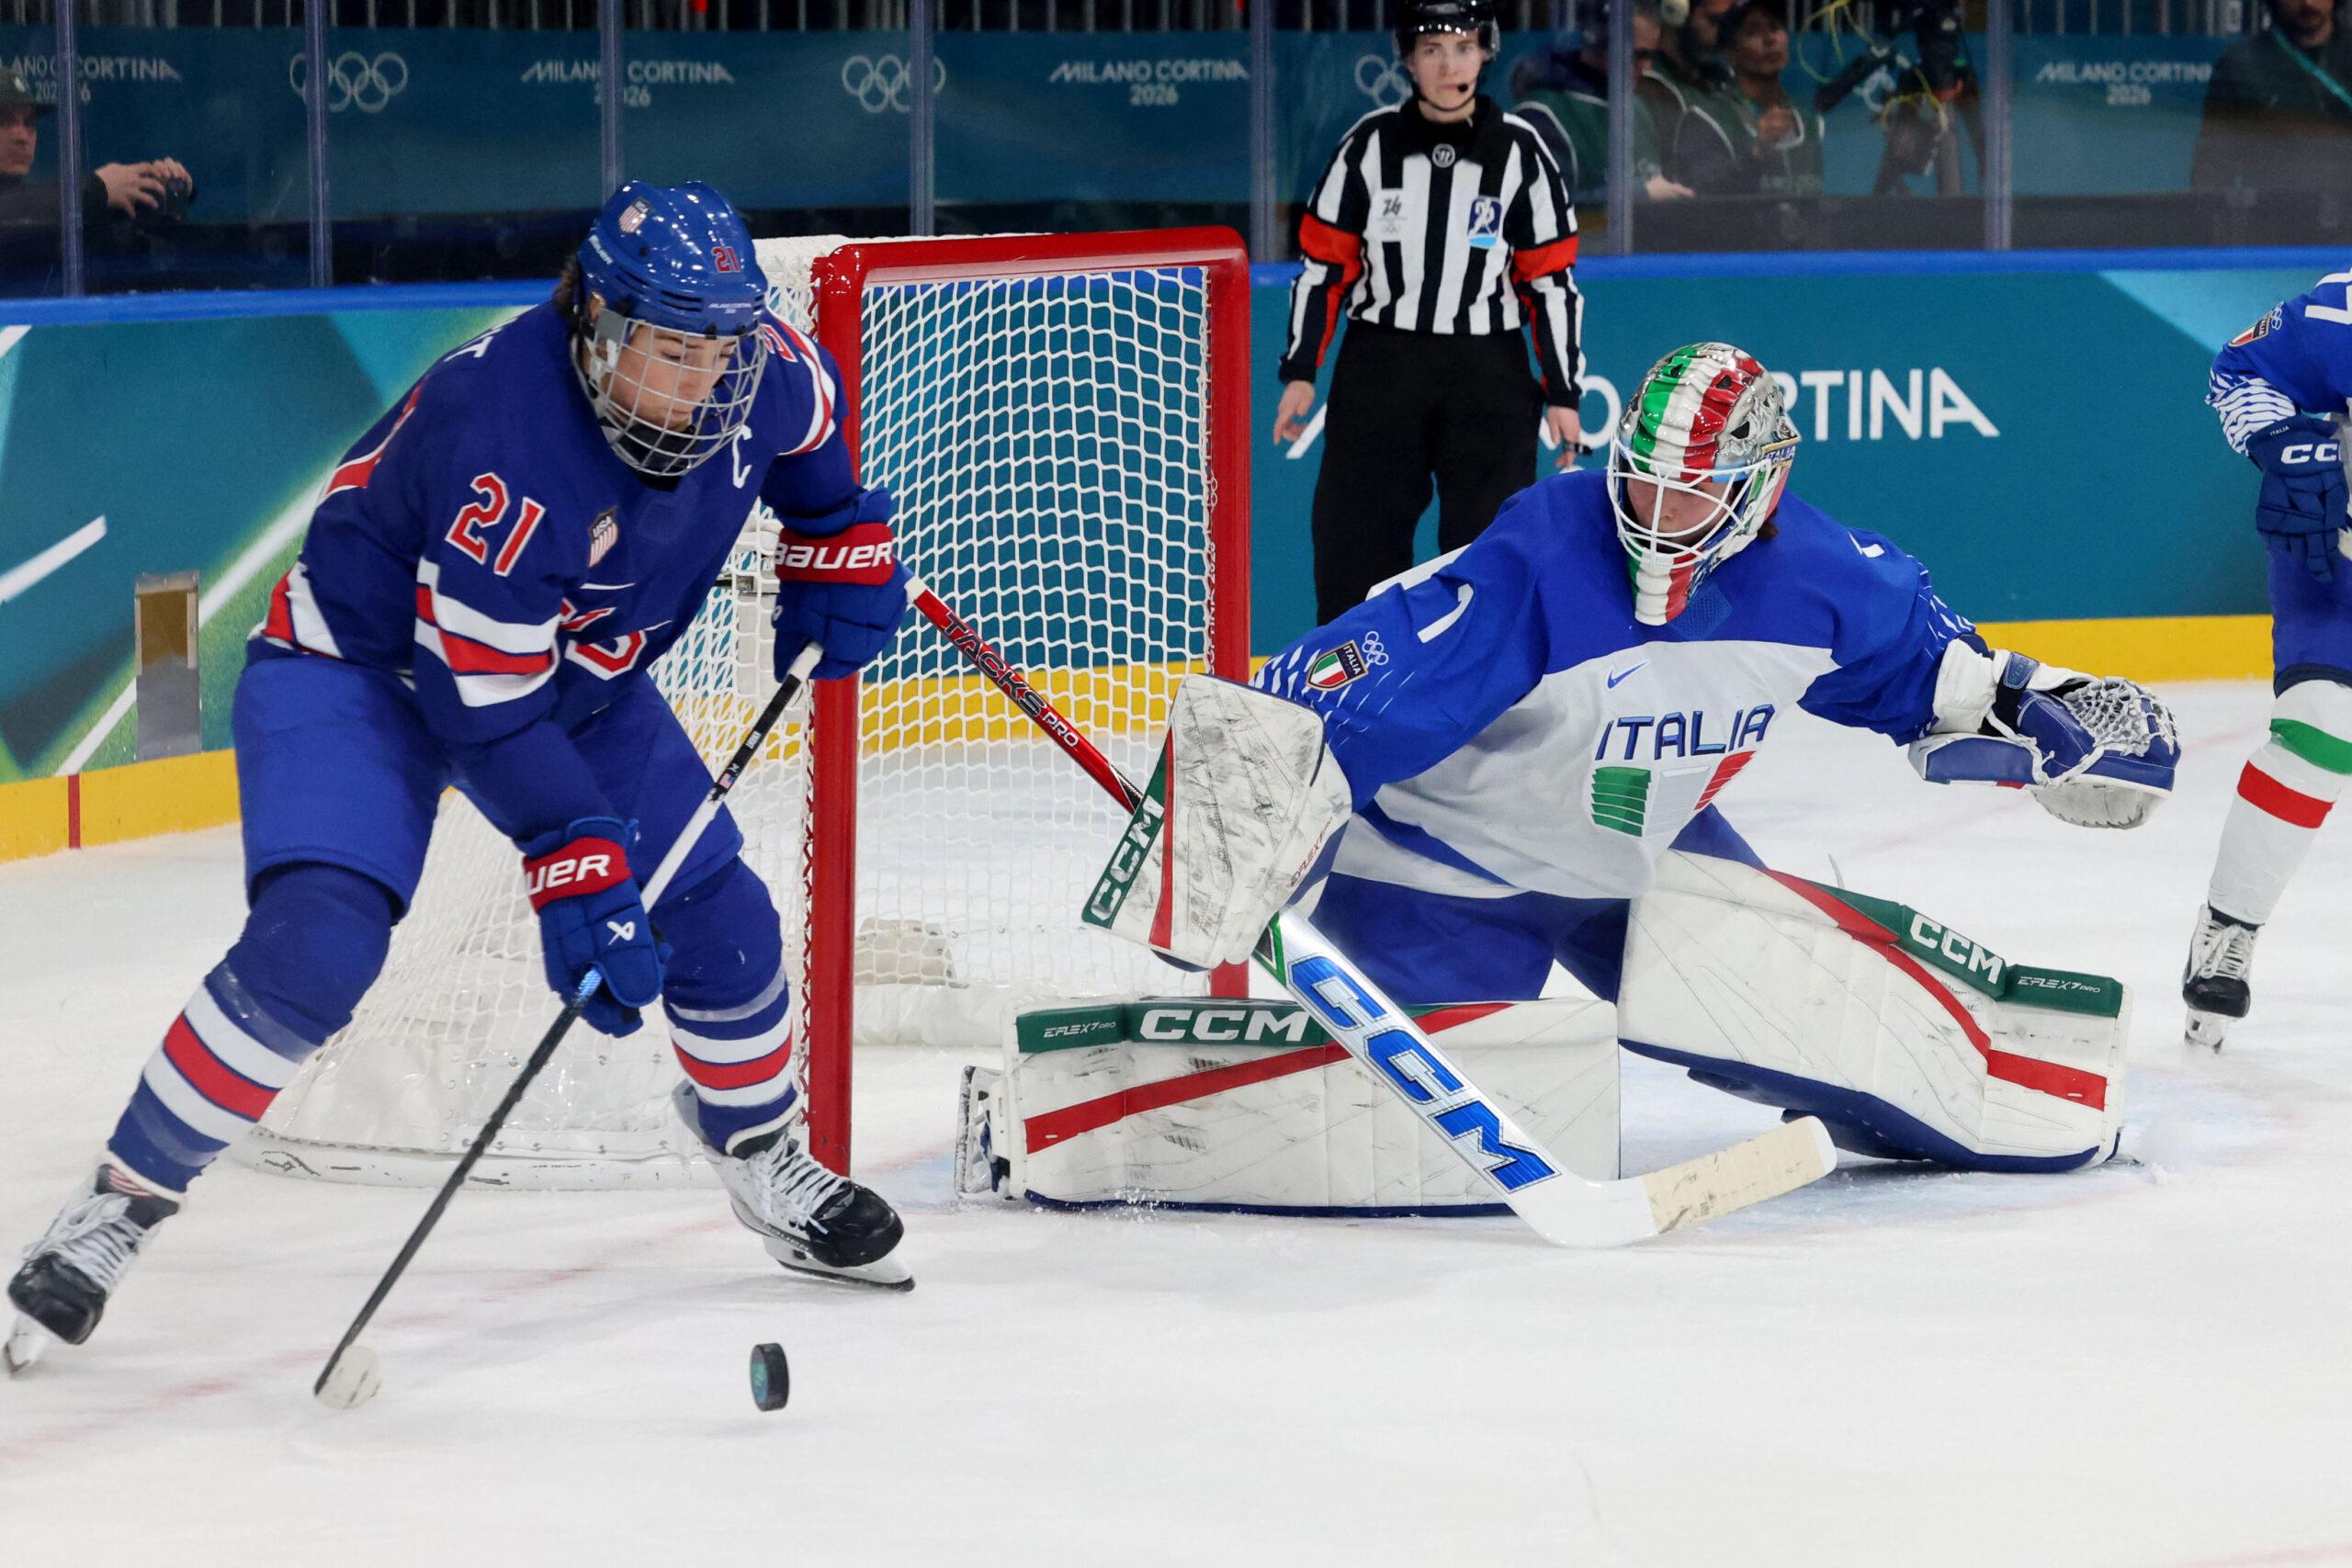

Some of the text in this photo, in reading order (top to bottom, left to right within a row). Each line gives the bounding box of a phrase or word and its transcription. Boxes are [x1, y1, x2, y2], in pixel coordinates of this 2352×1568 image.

[520, 60, 734, 84] MILAN CORTINA
[1048, 60, 1250, 83] MILANO CORTINA
[2036, 62, 2126, 83] MILANO
[1130, 84, 1179, 106] 2026
[711, 246, 741, 273] 21
[2269, 425, 2290, 436] ITALIA
[2280, 443, 2342, 465] CC
[445, 472, 547, 577] 21
[593, 515, 612, 538] USA
[1343, 645, 1362, 674] ITALIA
[944, 611, 1080, 748] TACKS PRO
[1595, 704, 1776, 761] ITALIA
[1091, 795, 1165, 920] CCM
[526, 853, 611, 897] UER
[1910, 912, 2005, 986] CCM
[1139, 1009, 1312, 1043] CCM
[1287, 953, 1562, 1194] CCM
